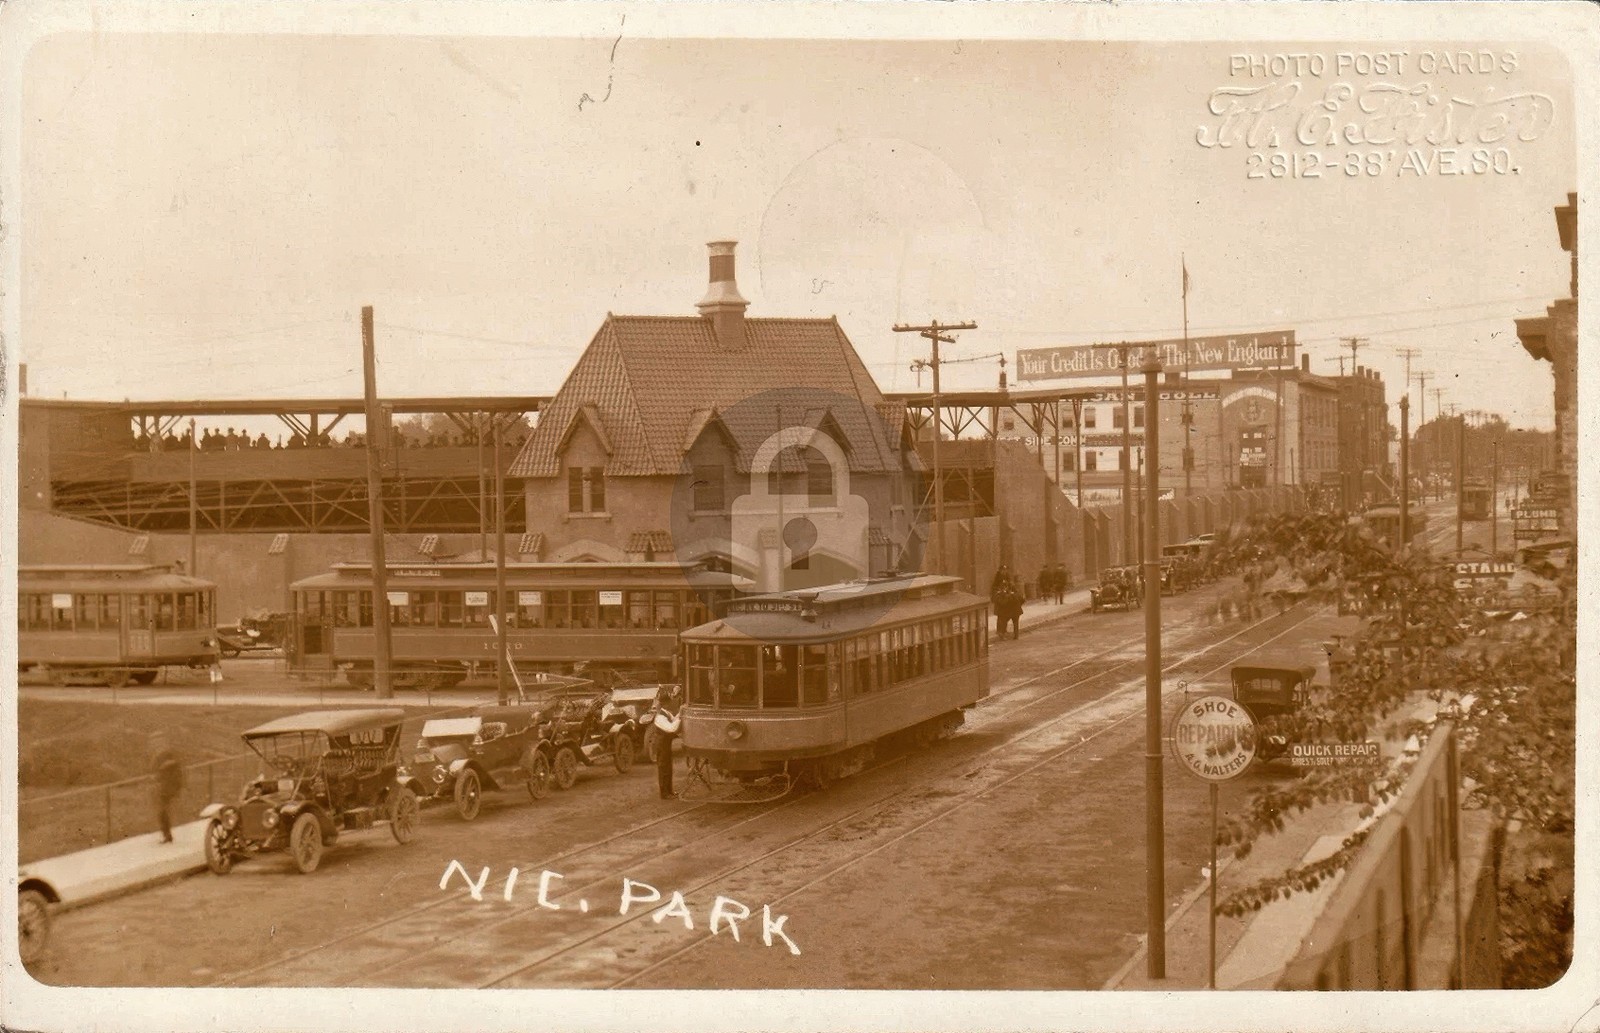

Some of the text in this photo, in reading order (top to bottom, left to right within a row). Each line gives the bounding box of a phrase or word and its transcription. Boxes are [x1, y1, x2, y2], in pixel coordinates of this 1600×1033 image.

[1020, 353, 1048, 375] Your
[1051, 350, 1088, 373] Credit
[1090, 348, 1104, 370] Is
[1107, 346, 1143, 370] God
[1163, 343, 1191, 366] The
[1195, 340, 1224, 365] New
[1192, 701, 1238, 719] SHOE
[1293, 744, 1332, 757] QUICK
